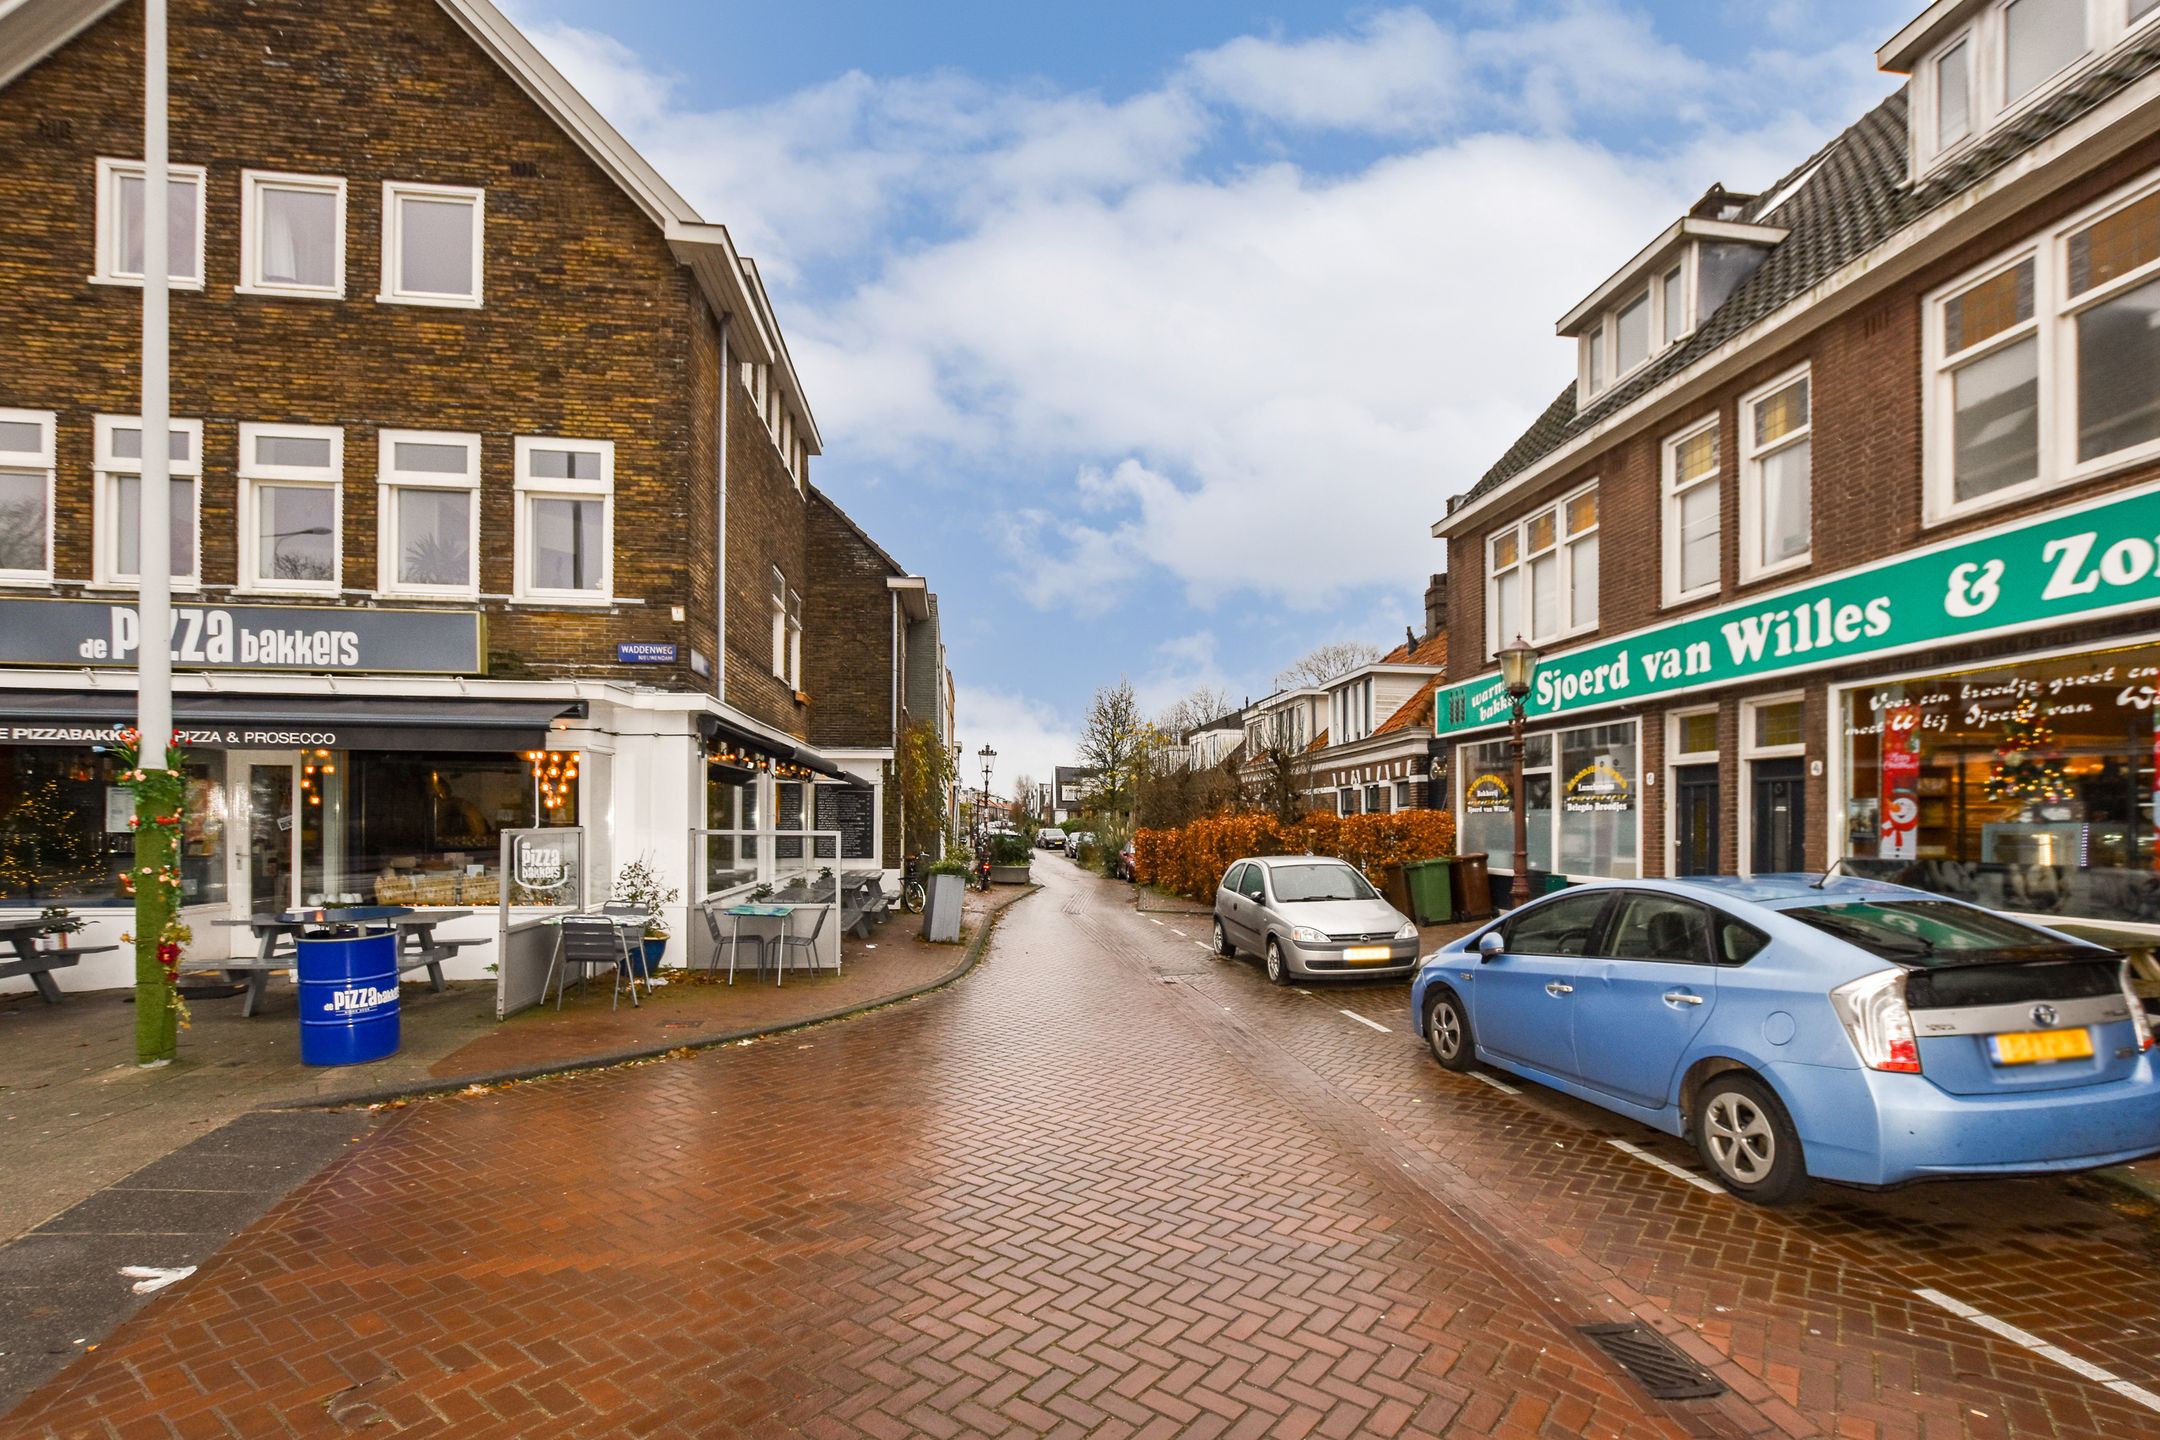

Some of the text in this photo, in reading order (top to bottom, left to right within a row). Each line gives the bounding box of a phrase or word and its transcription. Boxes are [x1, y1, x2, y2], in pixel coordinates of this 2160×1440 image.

[79, 606, 359, 666] de pza bakkers
[1536, 650, 1630, 711] Sjoerd
[1641, 640, 1712, 682] van
[1720, 596, 1891, 665] Willes
[1944, 559, 2005, 617] &
[621, 645, 673, 654] WADDENWEG
[1472, 681, 1505, 708] warm
[1869, 692, 1911, 711] Voor
[1920, 694, 1951, 706] een
[1961, 678, 2038, 699] broodje
[2049, 667, 2116, 695] groot
[1480, 695, 1518, 721] bakke
[1892, 715, 1914, 731] U
[1922, 714, 1948, 732] bij
[1963, 703, 2036, 728] Sjoerd
[2048, 703, 2093, 716] van
[0, 728, 9, 739] E
[174, 731, 336, 744] PIZZA & PROSECCO
[521, 849, 560, 867] pizza
[521, 866, 561, 879] bakkers
[334, 987, 377, 1010] pizza
